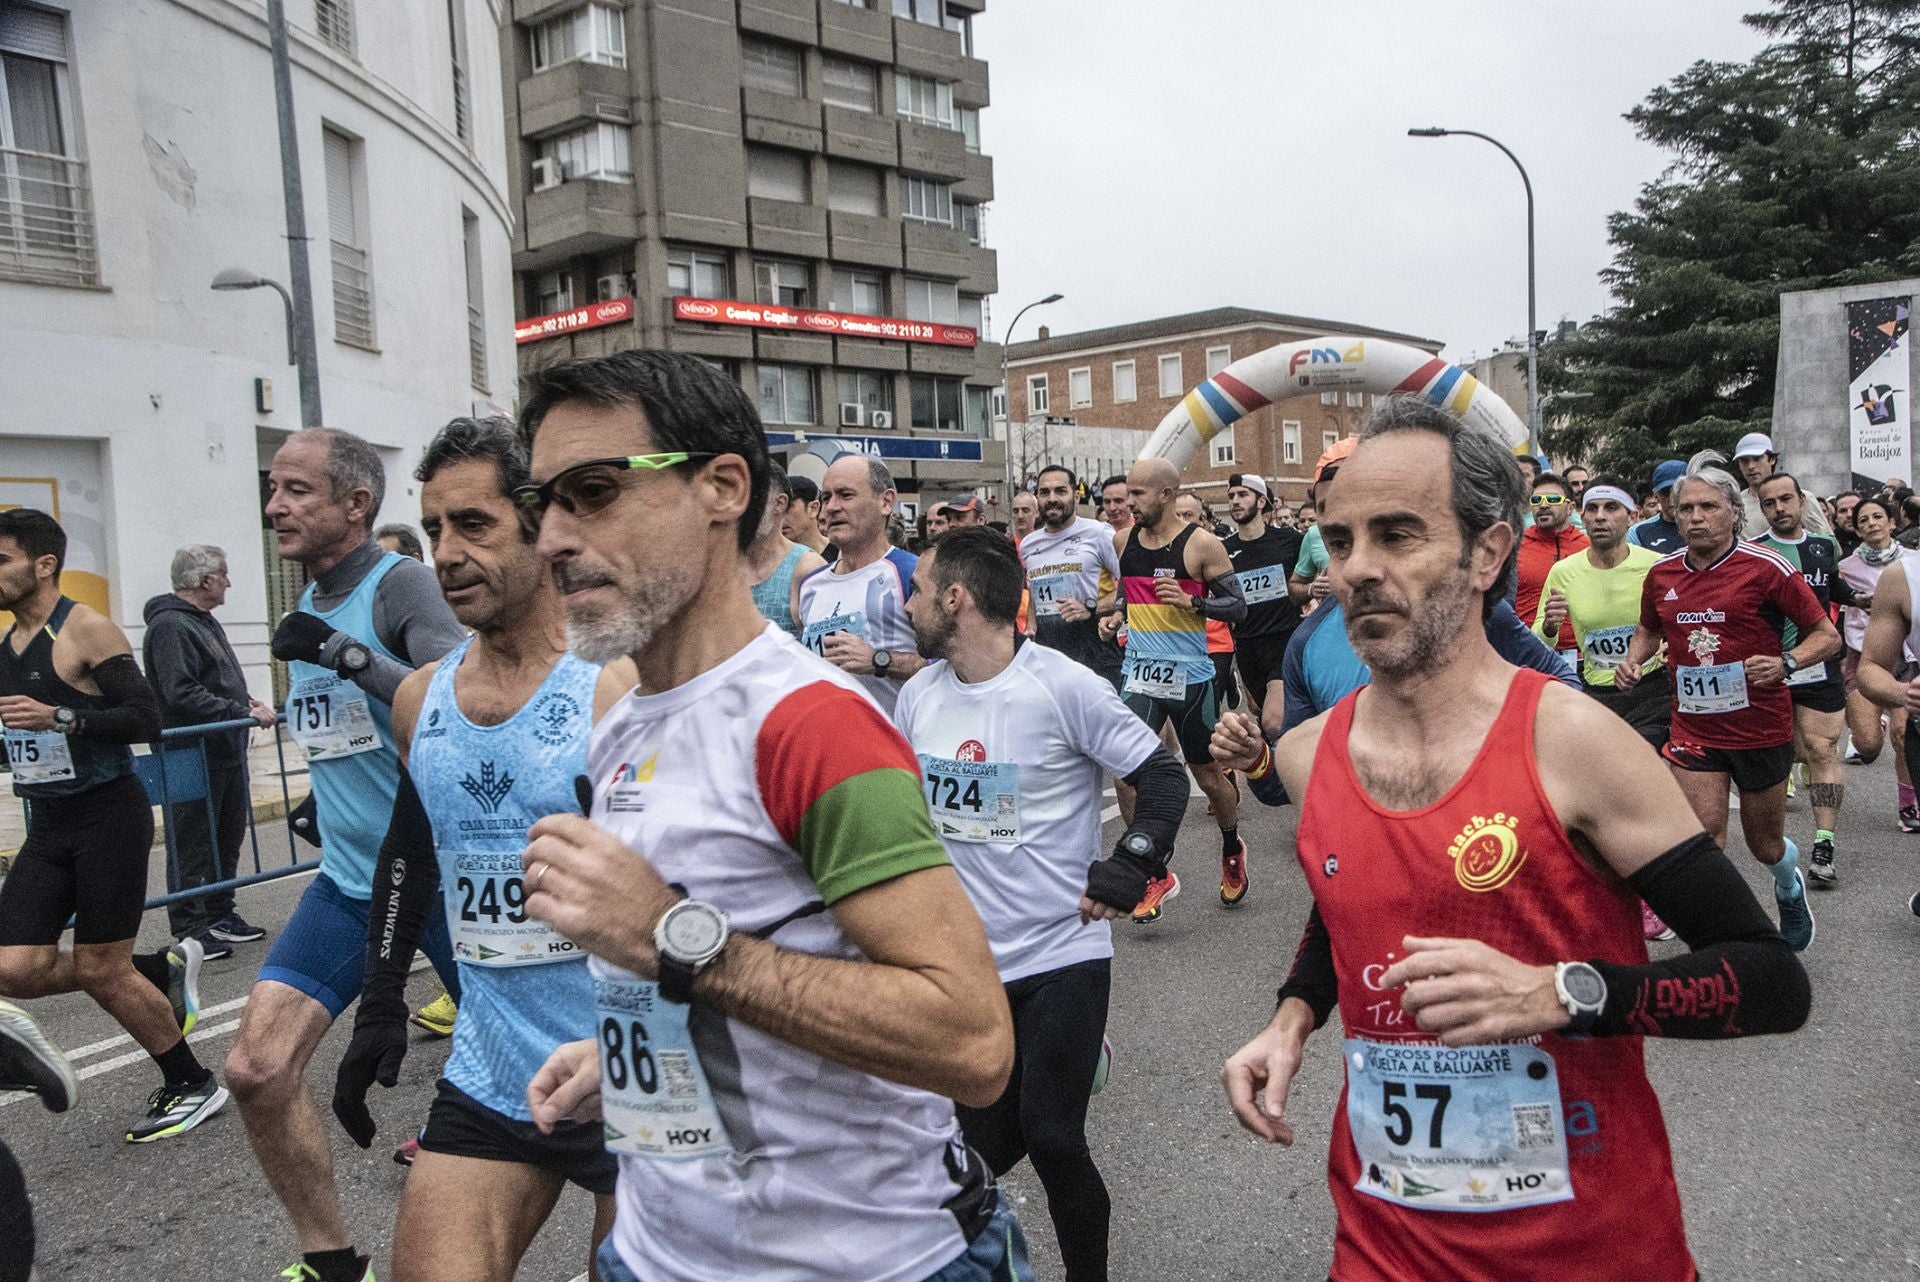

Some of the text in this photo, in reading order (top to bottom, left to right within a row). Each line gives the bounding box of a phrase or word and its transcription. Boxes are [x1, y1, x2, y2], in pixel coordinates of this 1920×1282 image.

[578, 311, 588, 324] 20
[726, 307, 798, 325] Centro Capilar
[881, 324, 897, 336] 902
[922, 326, 933, 338] 20
[1860, 444, 1902, 462] Badajoz
[1243, 574, 1272, 592] 272
[1038, 586, 1052, 602] 41
[1132, 664, 1174, 684] 1042
[1683, 676, 1720, 697] 511
[1730, 700, 1745, 708] HOY
[293, 694, 330, 732] 757
[349, 734, 374, 747] HOY
[927, 773, 983, 812] 724
[459, 820, 485, 831] CAJA
[990, 828, 1016, 837] HOY
[471, 854, 500, 862] CROSS
[488, 862, 498, 871] AL
[457, 876, 529, 924] 249
[380, 890, 400, 960] SALOMON
[603, 1017, 658, 1094] 86
[1386, 1048, 1431, 1060] CROSS
[1436, 1049, 1511, 1061] POPULAR
[1368, 1058, 1512, 1074] VUELTA AL BALUARTE
[1382, 1080, 1452, 1149] 57
[666, 1128, 712, 1145] HOY
